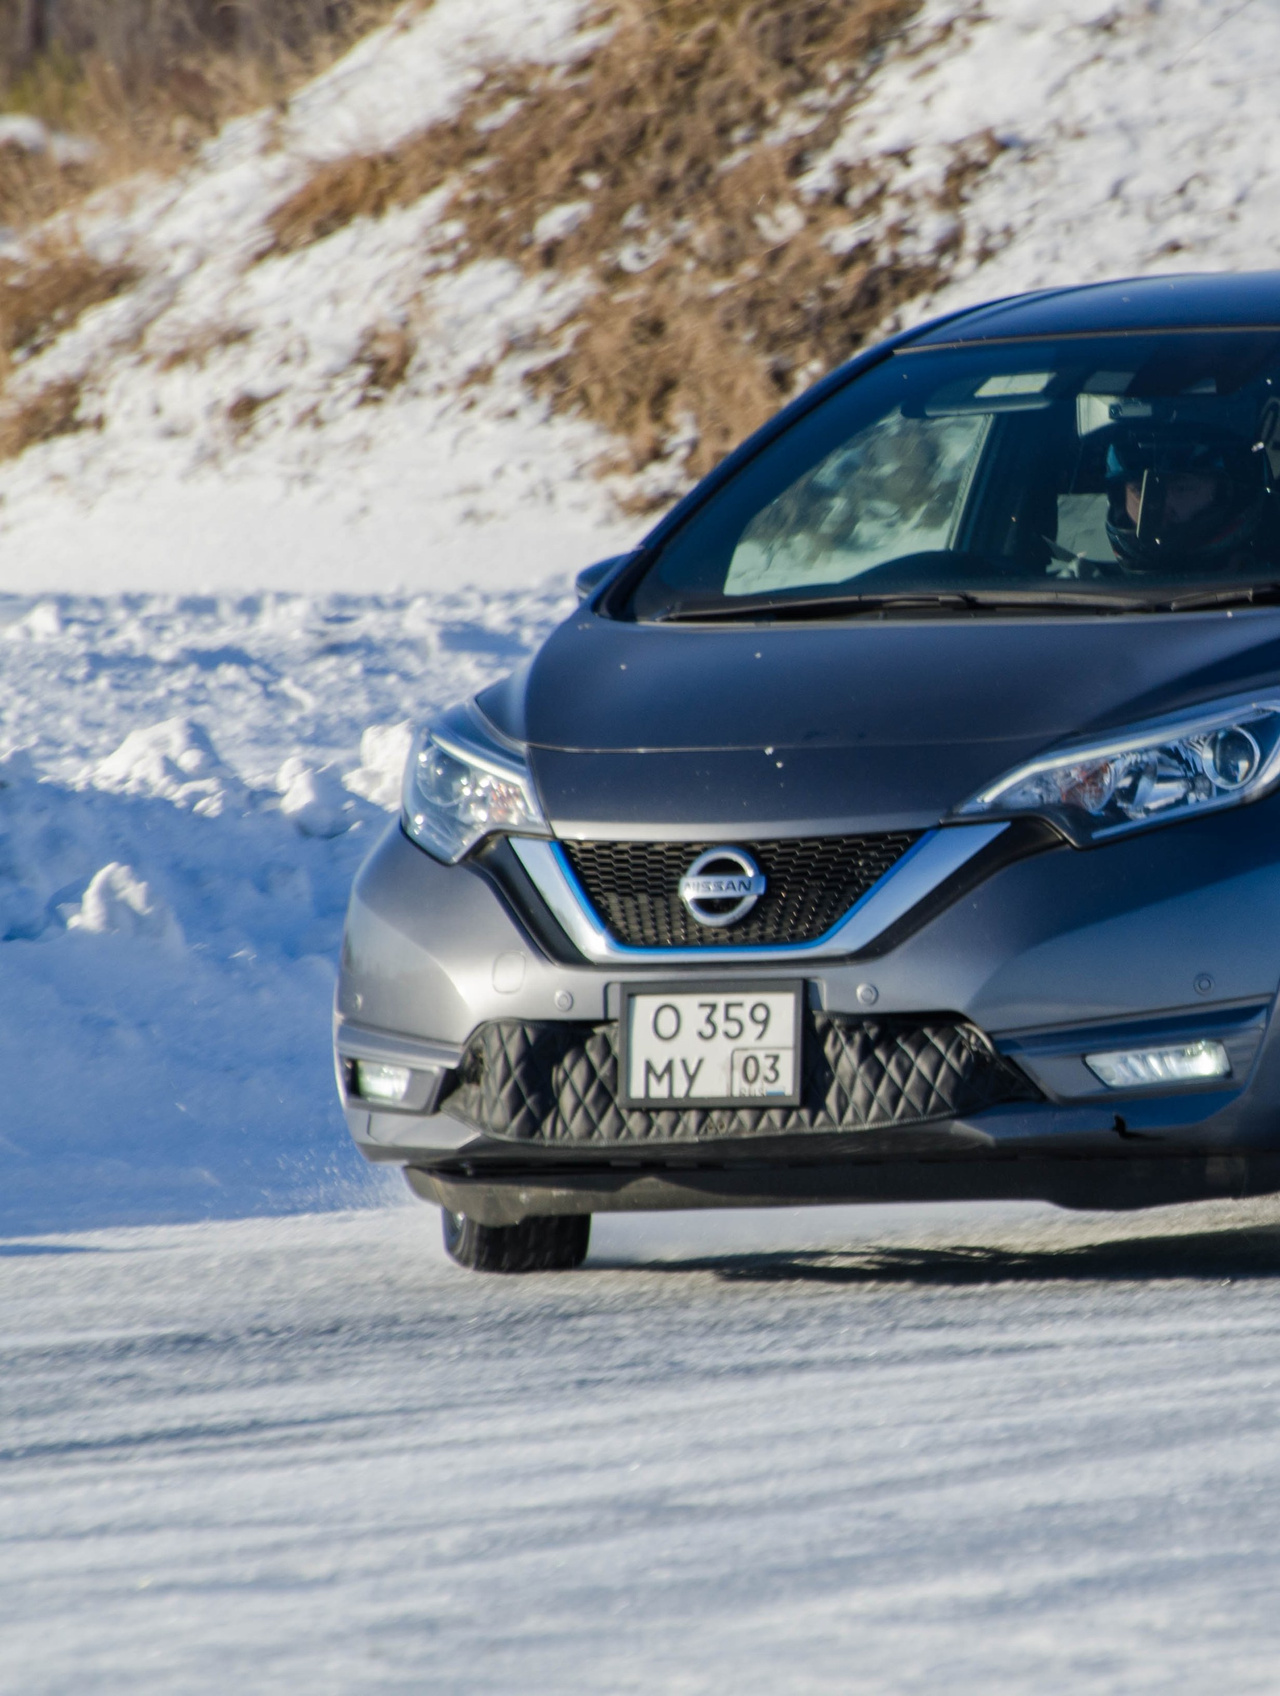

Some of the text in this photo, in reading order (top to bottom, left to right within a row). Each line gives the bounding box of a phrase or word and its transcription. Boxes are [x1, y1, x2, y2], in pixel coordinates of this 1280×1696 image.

[684, 880, 752, 893] NISSAN
[696, 1002, 771, 1041] 359
[742, 1054, 781, 1085] 03
